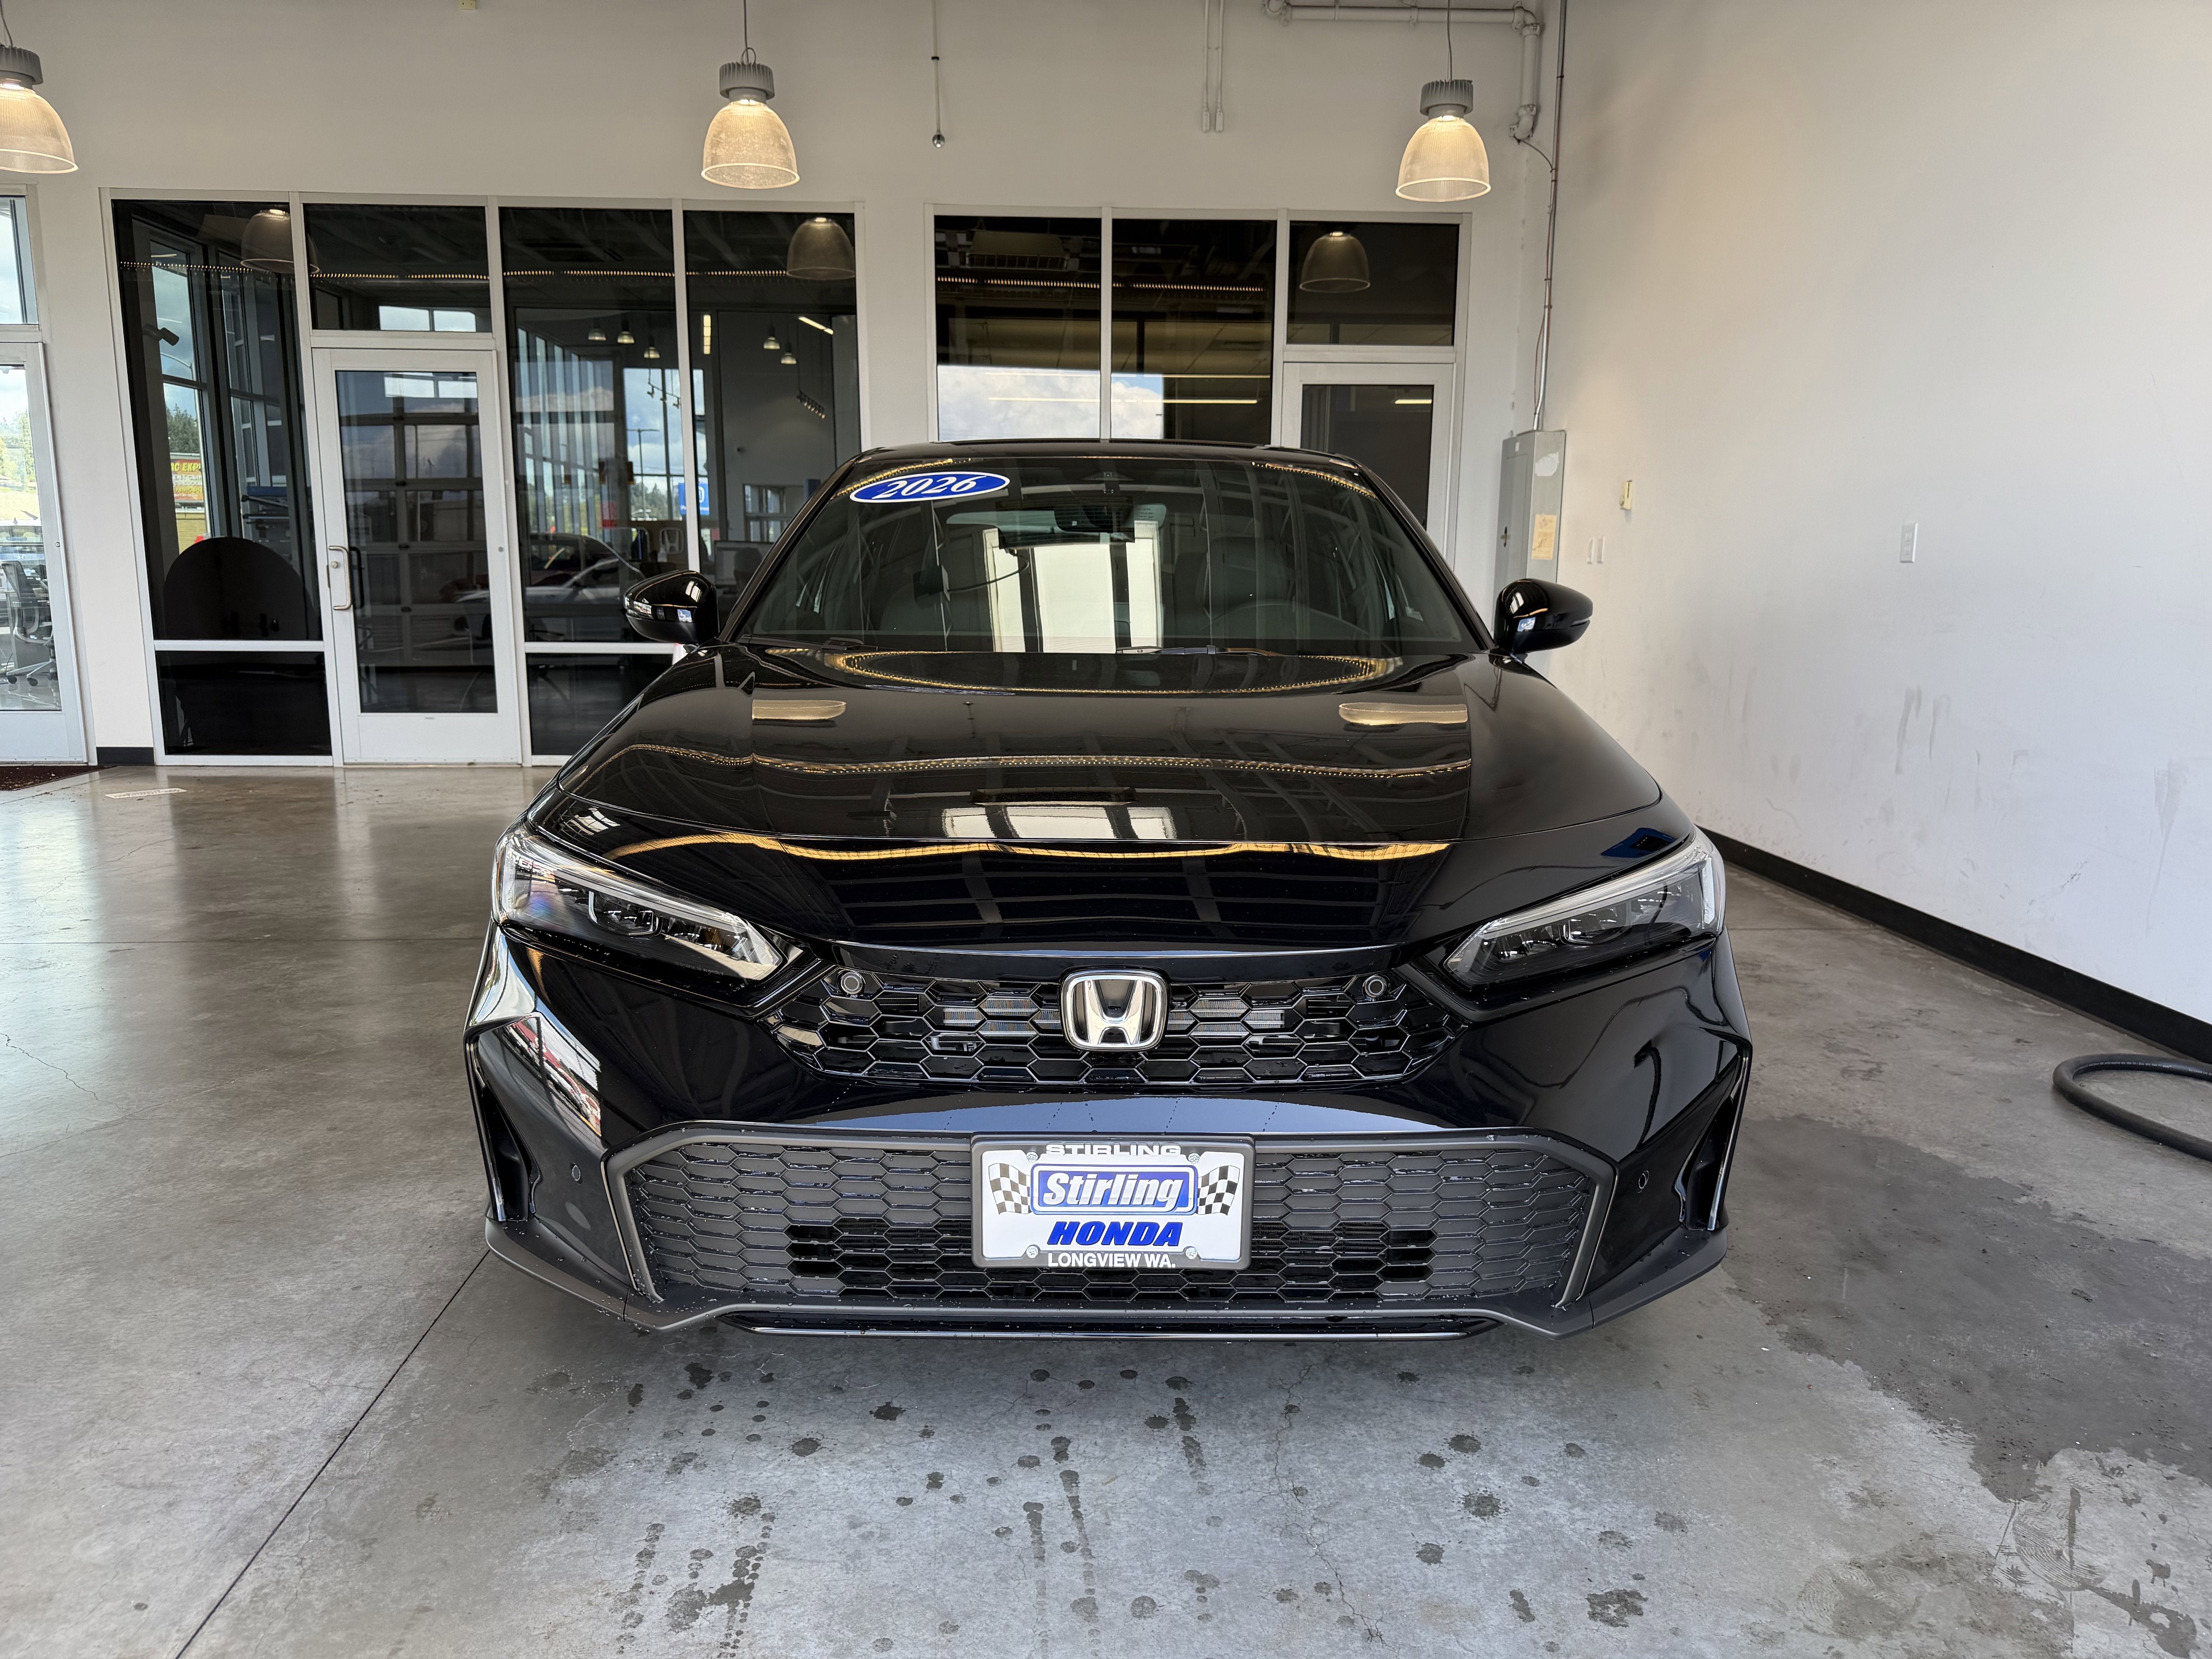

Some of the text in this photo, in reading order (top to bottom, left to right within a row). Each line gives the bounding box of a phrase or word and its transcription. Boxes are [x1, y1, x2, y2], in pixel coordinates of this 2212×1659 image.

[872, 476, 987, 500] 2026
[1046, 1142, 1181, 1156] STIRLING
[1042, 1173, 1183, 1212] Stirling
[1047, 1221, 1183, 1247] HONDA
[1048, 1252, 1176, 1268] LONGVIEW WA.
